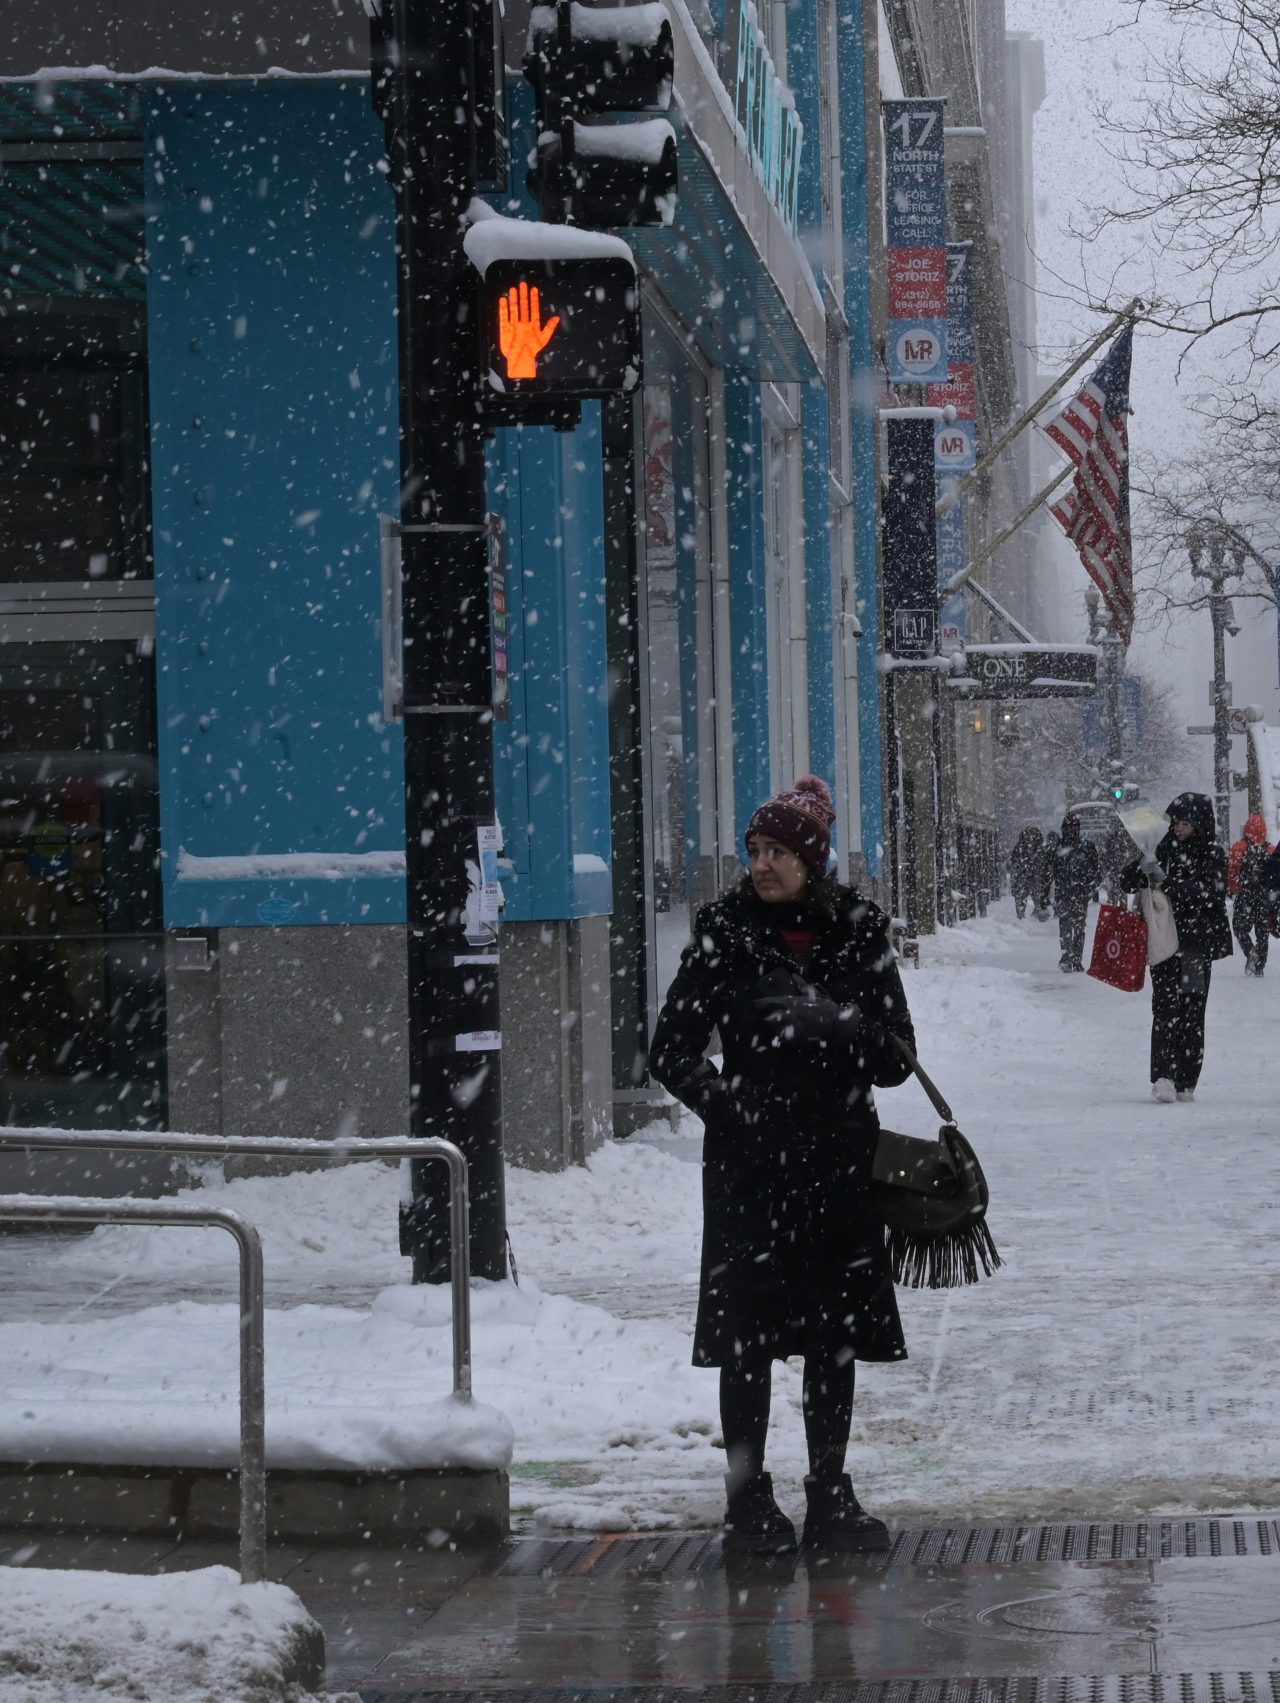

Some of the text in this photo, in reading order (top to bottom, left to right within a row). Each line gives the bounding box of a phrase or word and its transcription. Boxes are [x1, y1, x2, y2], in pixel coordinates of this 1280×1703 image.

[892, 111, 938, 149] 17
[893, 151, 939, 161] NORTH
[894, 164, 938, 173] STATE ST
[905, 191, 927, 200] FOR
[898, 203, 937, 213] OFFICE
[894, 216, 940, 226] LEASING
[902, 229, 928, 238] CALL
[905, 259, 930, 269] JOE
[895, 272, 940, 282] STORIZ
[933, 383, 970, 391] STORIZ
[902, 617, 927, 637] GAP
[983, 659, 1026, 677] ONE
